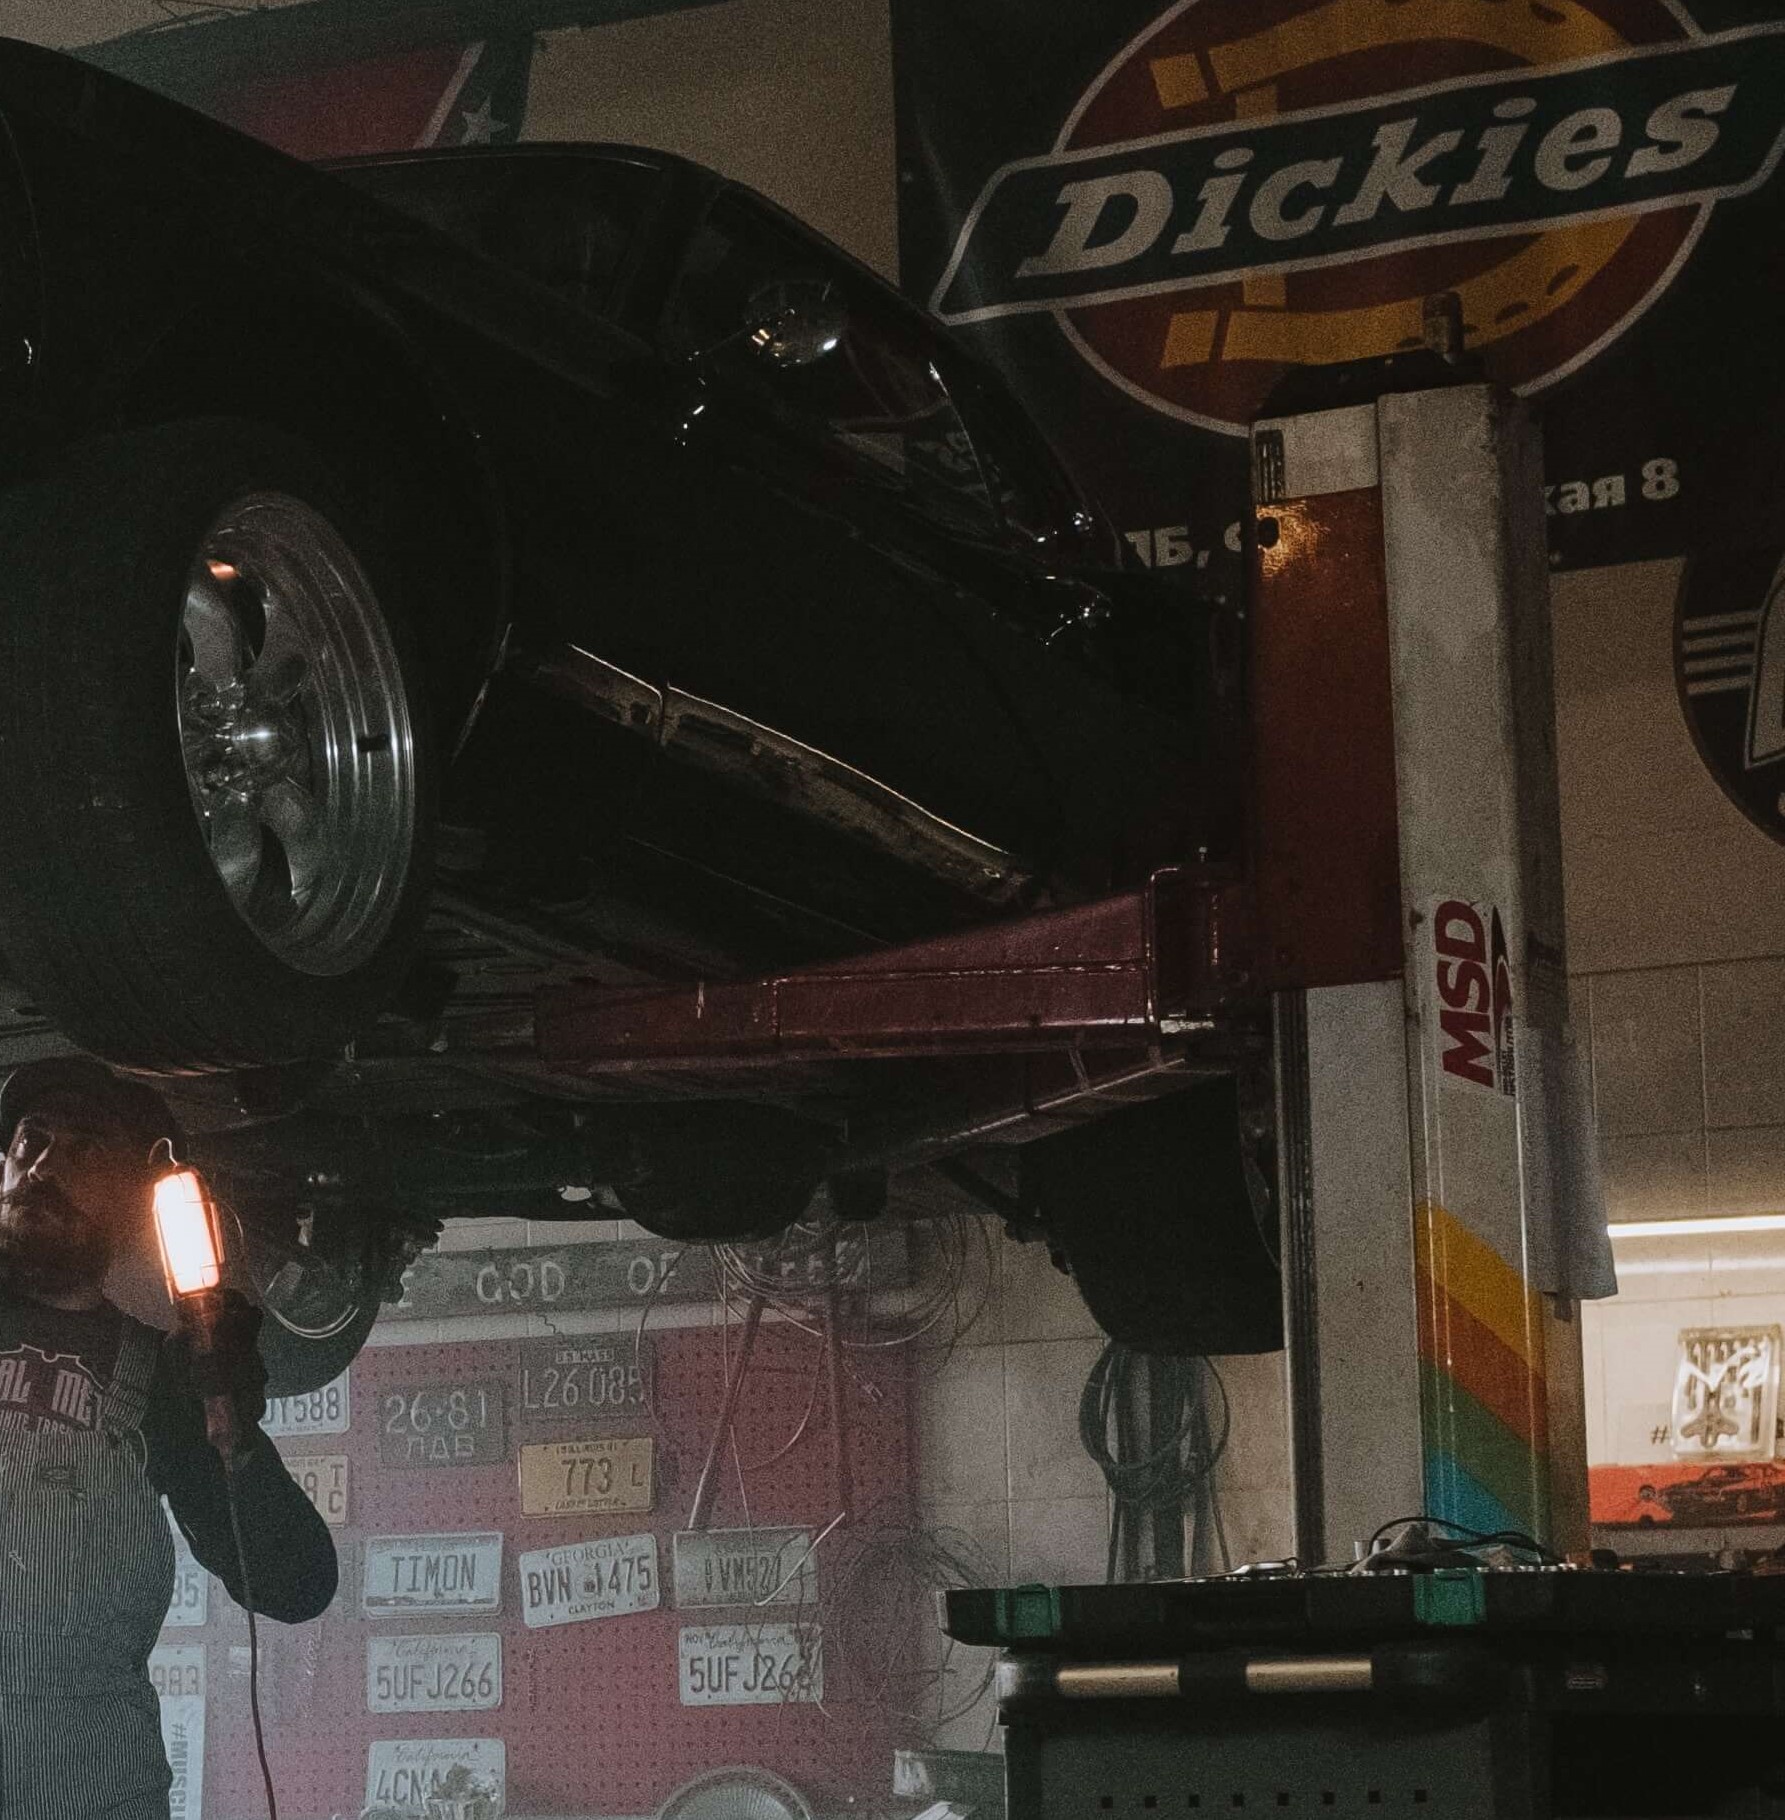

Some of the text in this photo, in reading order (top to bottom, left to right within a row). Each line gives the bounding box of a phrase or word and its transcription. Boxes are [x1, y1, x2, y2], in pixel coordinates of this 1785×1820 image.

[1015, 83, 1738, 278] Dickies
[1641, 457, 1680, 500] 8
[1434, 899, 1494, 1089] MSD
[477, 1261, 566, 1301] GOD
[627, 1251, 680, 1296] OF
[562, 1458, 643, 1495] 773 L
[391, 1554, 477, 1594] TIMON
[551, 1543, 625, 1566] GEORGIA
[528, 1555, 651, 1608] BVN 1475
[568, 1600, 616, 1616] CLAYTON
[377, 1662, 493, 1700] 5UFJ266
